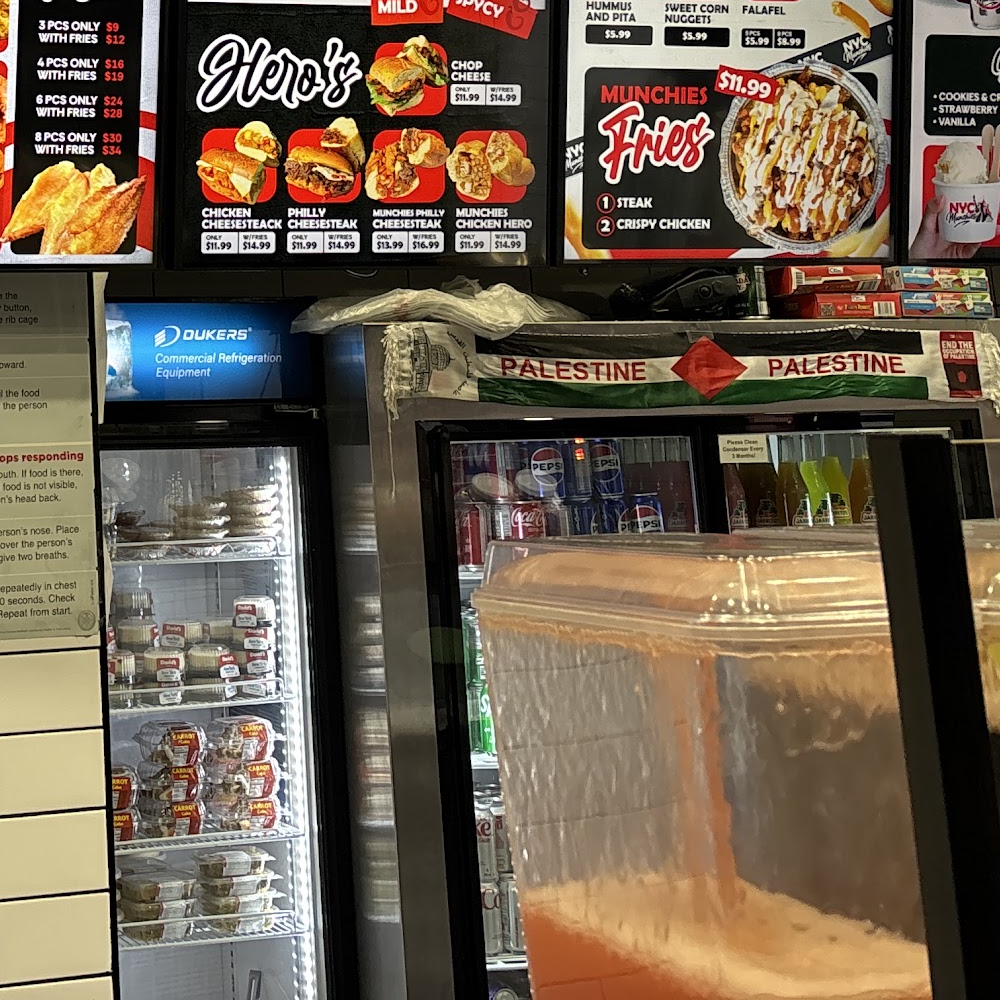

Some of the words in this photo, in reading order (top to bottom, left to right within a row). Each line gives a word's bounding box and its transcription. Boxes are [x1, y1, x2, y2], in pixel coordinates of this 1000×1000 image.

[586, 1, 632, 11] HUMMUS
[665, 4, 697, 14] SWEET
[700, 4, 729, 14] CORN
[586, 12, 609, 22] AND
[612, 12, 636, 23] PITA
[665, 14, 711, 24] NUGGETS
[38, 20, 46, 30] 3
[47, 21, 68, 32] PCS
[70, 21, 101, 34] ONLY
[106, 22, 120, 33] $9
[604, 29, 631, 39] $5.99
[451, 60, 483, 71] CHOP
[198, 36, 360, 111] Hero's
[451, 71, 491, 82] CHEESE
[718, 73, 772, 99] $11.99
[455, 94, 480, 102] $11.99
[601, 85, 708, 105] MUNCHIES
[939, 92, 980, 101] COOKIES
[938, 104, 998, 114] STRAWBERRY
[938, 117, 976, 126] VANILLA
[600, 103, 713, 182] Fries
[617, 197, 653, 209] STEAK
[202, 207, 251, 218] CHICKEN
[288, 207, 326, 218] PHILLY
[202, 218, 282, 230] CHEESESTEACK
[288, 219, 358, 230] CHEESESTEAK
[617, 219, 657, 231] CRISPY
[659, 219, 711, 230] CHICKEN
[941, 340, 957, 349] END
[958, 341, 974, 349] THE
[155, 352, 216, 364] Commercial
[218, 352, 282, 365] Refrigeration
[501, 358, 646, 381] PALESTINE
[768, 355, 906, 377] PALESTINE
[155, 366, 211, 379] Equipment
[6, 389, 18, 397] the
[21, 389, 39, 397] food
[21, 451, 84, 463] responding
[533, 461, 563, 471] PEPSI
[30, 527, 53, 536] nose.
[56, 525, 79, 534] Place
[174, 804, 196, 812] CARROT
